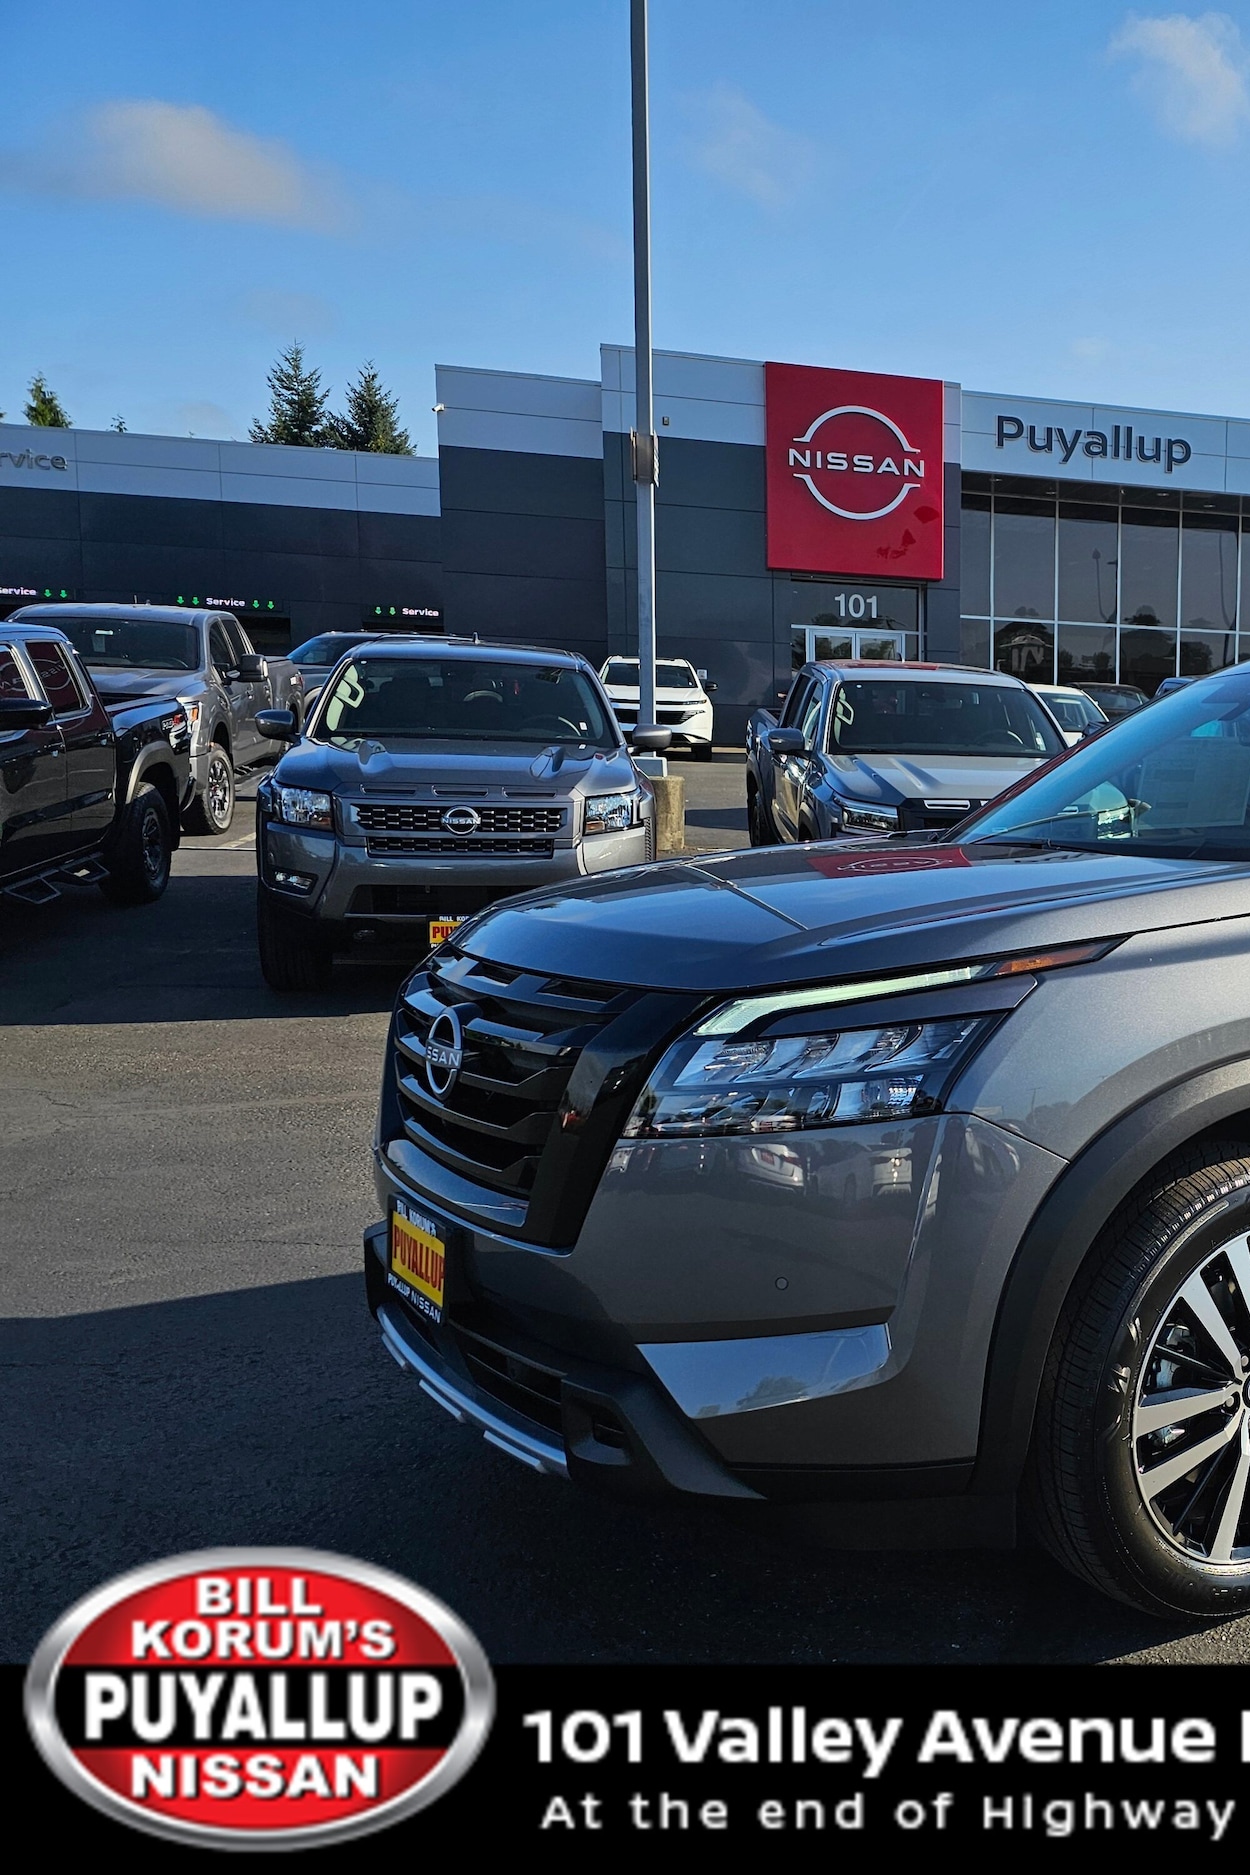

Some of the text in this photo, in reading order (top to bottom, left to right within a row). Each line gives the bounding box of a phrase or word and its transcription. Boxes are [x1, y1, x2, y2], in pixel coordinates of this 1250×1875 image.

[996, 414, 1192, 474] Puyallup
[788, 448, 925, 478] NISSAN
[205, 597, 246, 607] Service
[401, 607, 439, 617] Service
[834, 593, 877, 619] 101
[426, 1046, 460, 1067] SSAN
[394, 1224, 445, 1293] PUYALLUP
[411, 1289, 441, 1324] NISSAN
